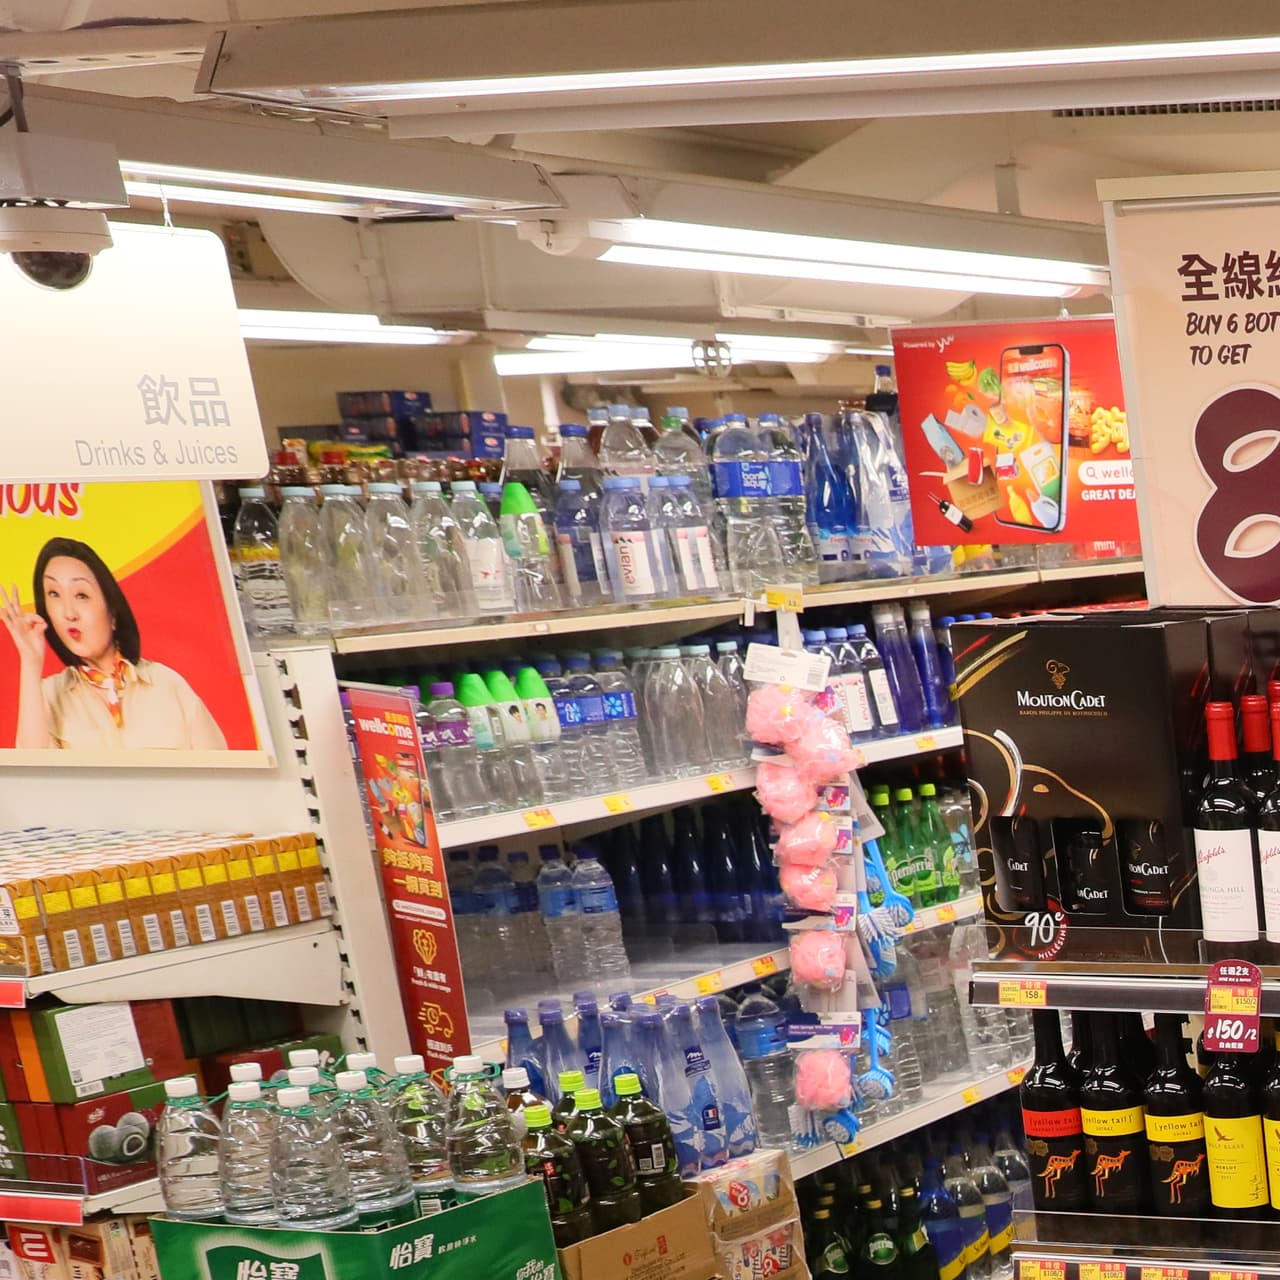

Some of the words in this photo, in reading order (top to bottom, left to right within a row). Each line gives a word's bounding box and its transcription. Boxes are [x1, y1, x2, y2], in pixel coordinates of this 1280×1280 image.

[1186, 312, 1221, 336] BUY
[1227, 313, 1238, 333] 6
[1190, 345, 1213, 365] TO
[1217, 344, 1251, 364] GET
[136, 375, 231, 429] 飲品
[75, 440, 149, 467] Drinks
[153, 441, 168, 465] &
[175, 440, 238, 466] Juices
[389, 1235, 434, 1270] 怡寶
